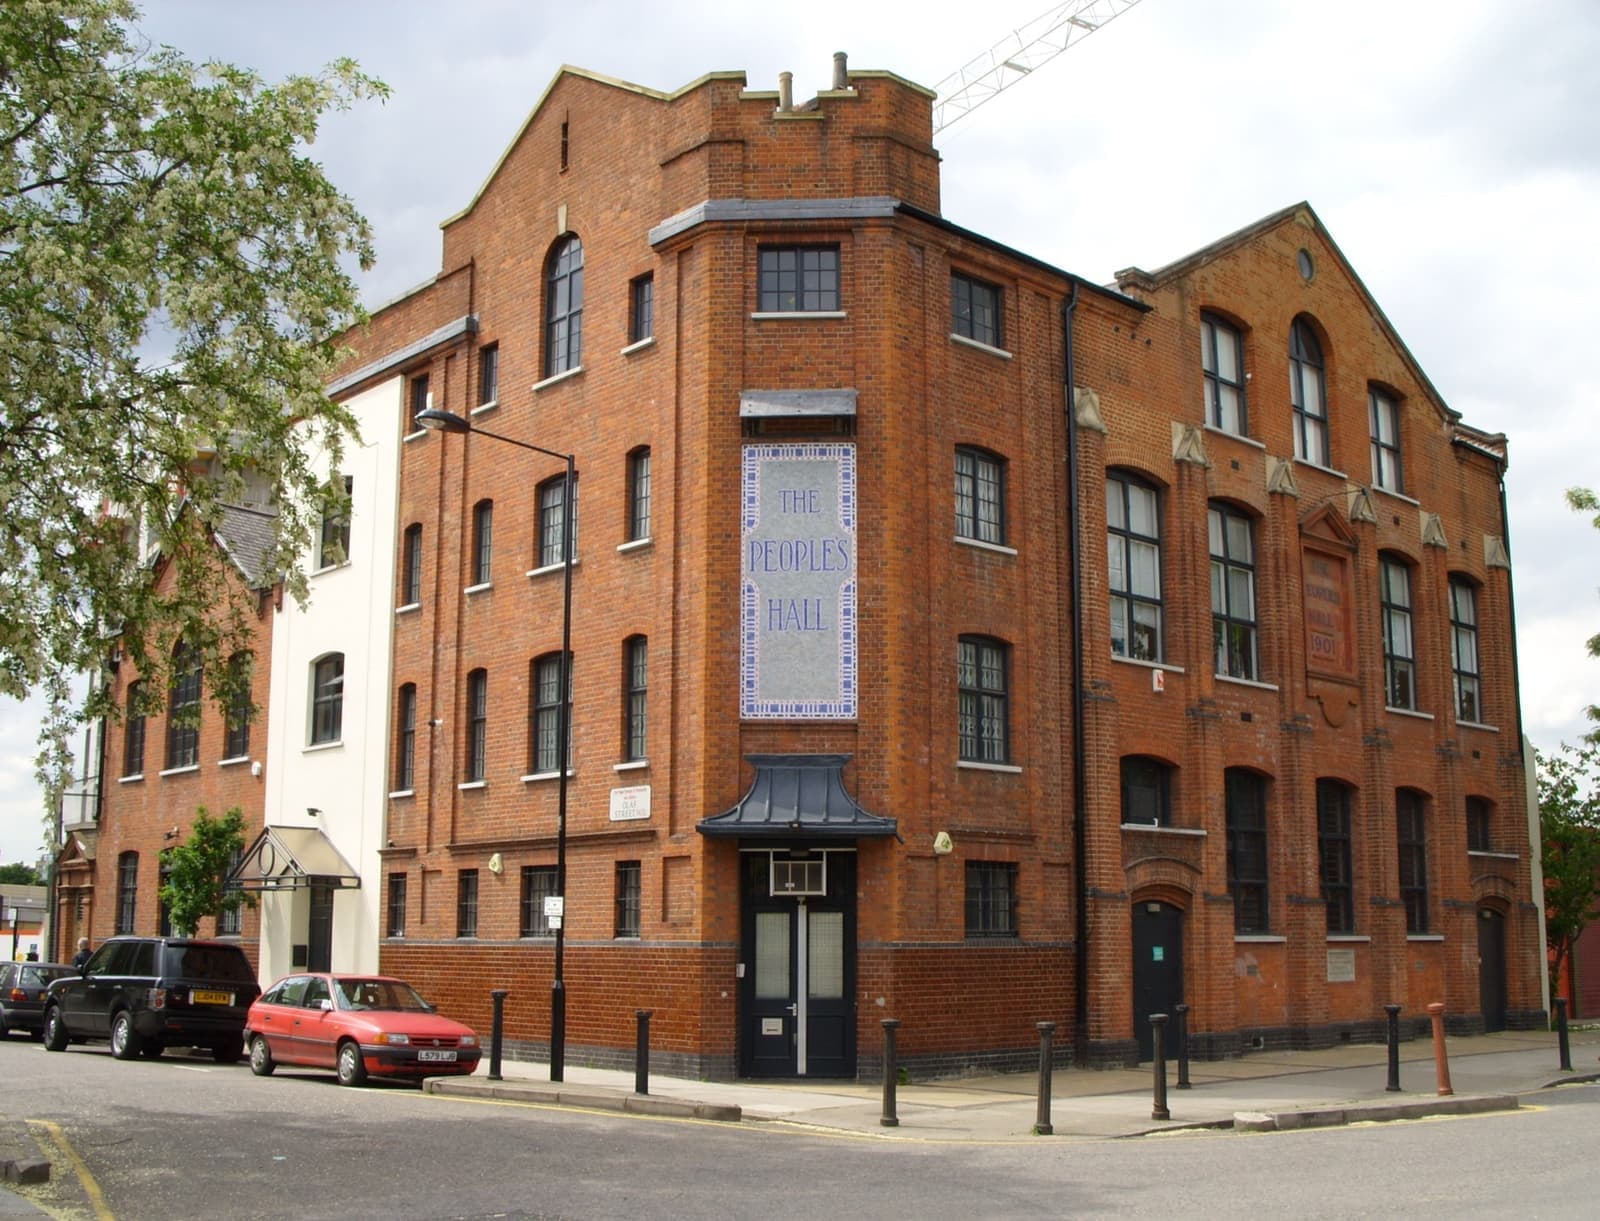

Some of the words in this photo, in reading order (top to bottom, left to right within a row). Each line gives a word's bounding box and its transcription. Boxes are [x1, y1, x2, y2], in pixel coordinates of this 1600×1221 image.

[779, 489, 821, 513] THE
[768, 599, 828, 631] HALL
[1311, 634, 1336, 655] 1901
